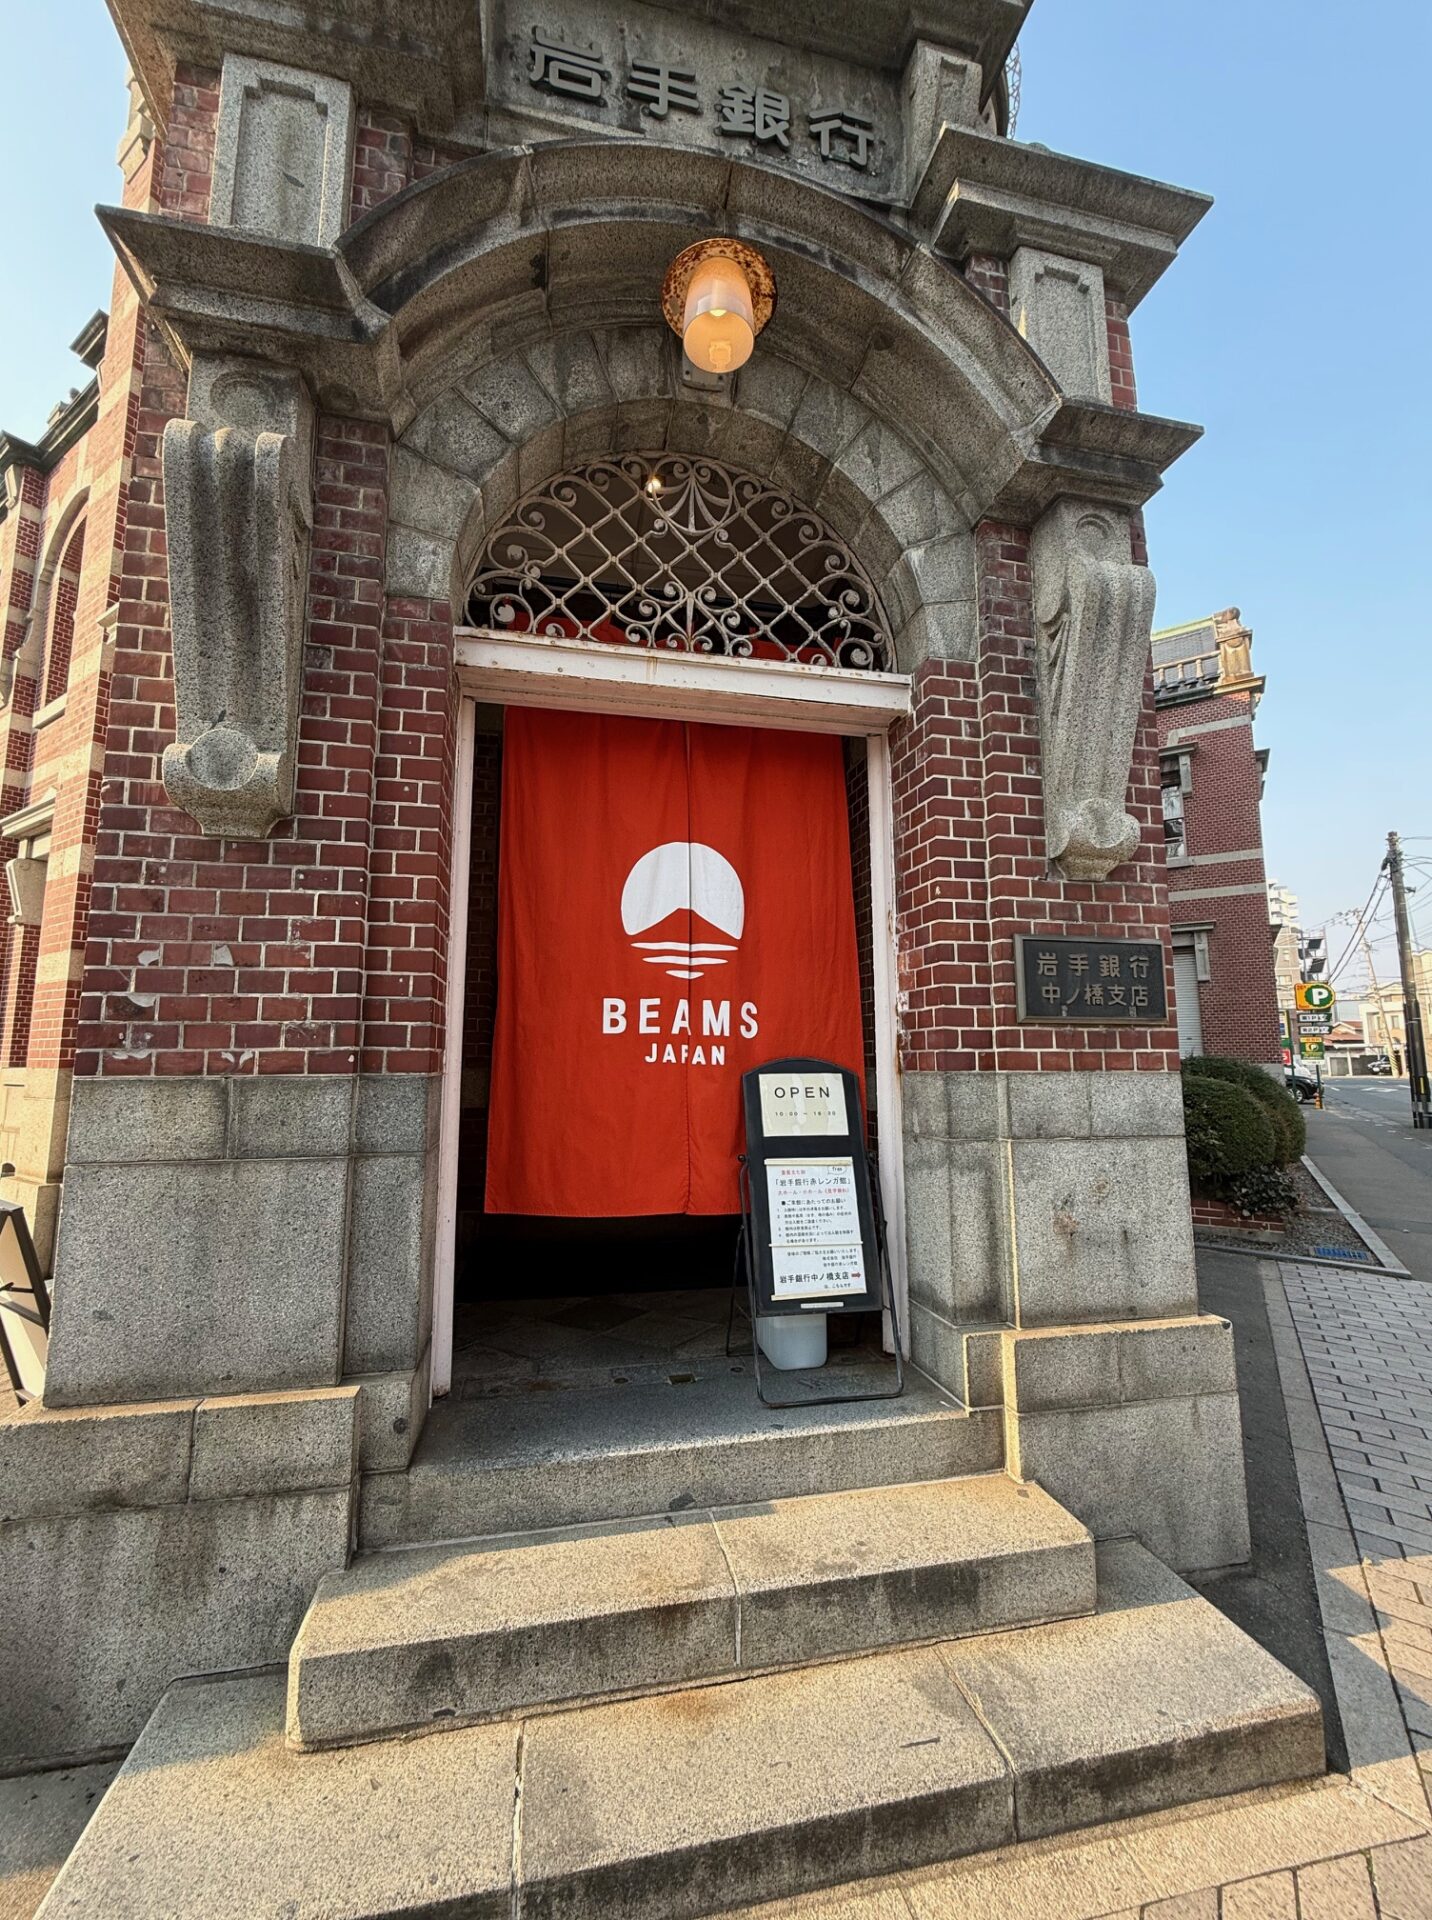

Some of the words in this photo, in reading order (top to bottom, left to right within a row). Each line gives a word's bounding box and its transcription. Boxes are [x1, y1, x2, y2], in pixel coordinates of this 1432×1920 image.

[529, 26, 875, 168] 岩手銀行
[1036, 952, 1149, 978] 岩手銀行
[1041, 982, 1149, 1006] 中ノ橋支店
[1311, 988, 1329, 1005] P
[602, 997, 759, 1039] BEAMS
[644, 1043, 726, 1066] JAPAN
[774, 1086, 830, 1098] OPEN
[779, 1271, 849, 1284] 岩手銀行中ノ橋支店
